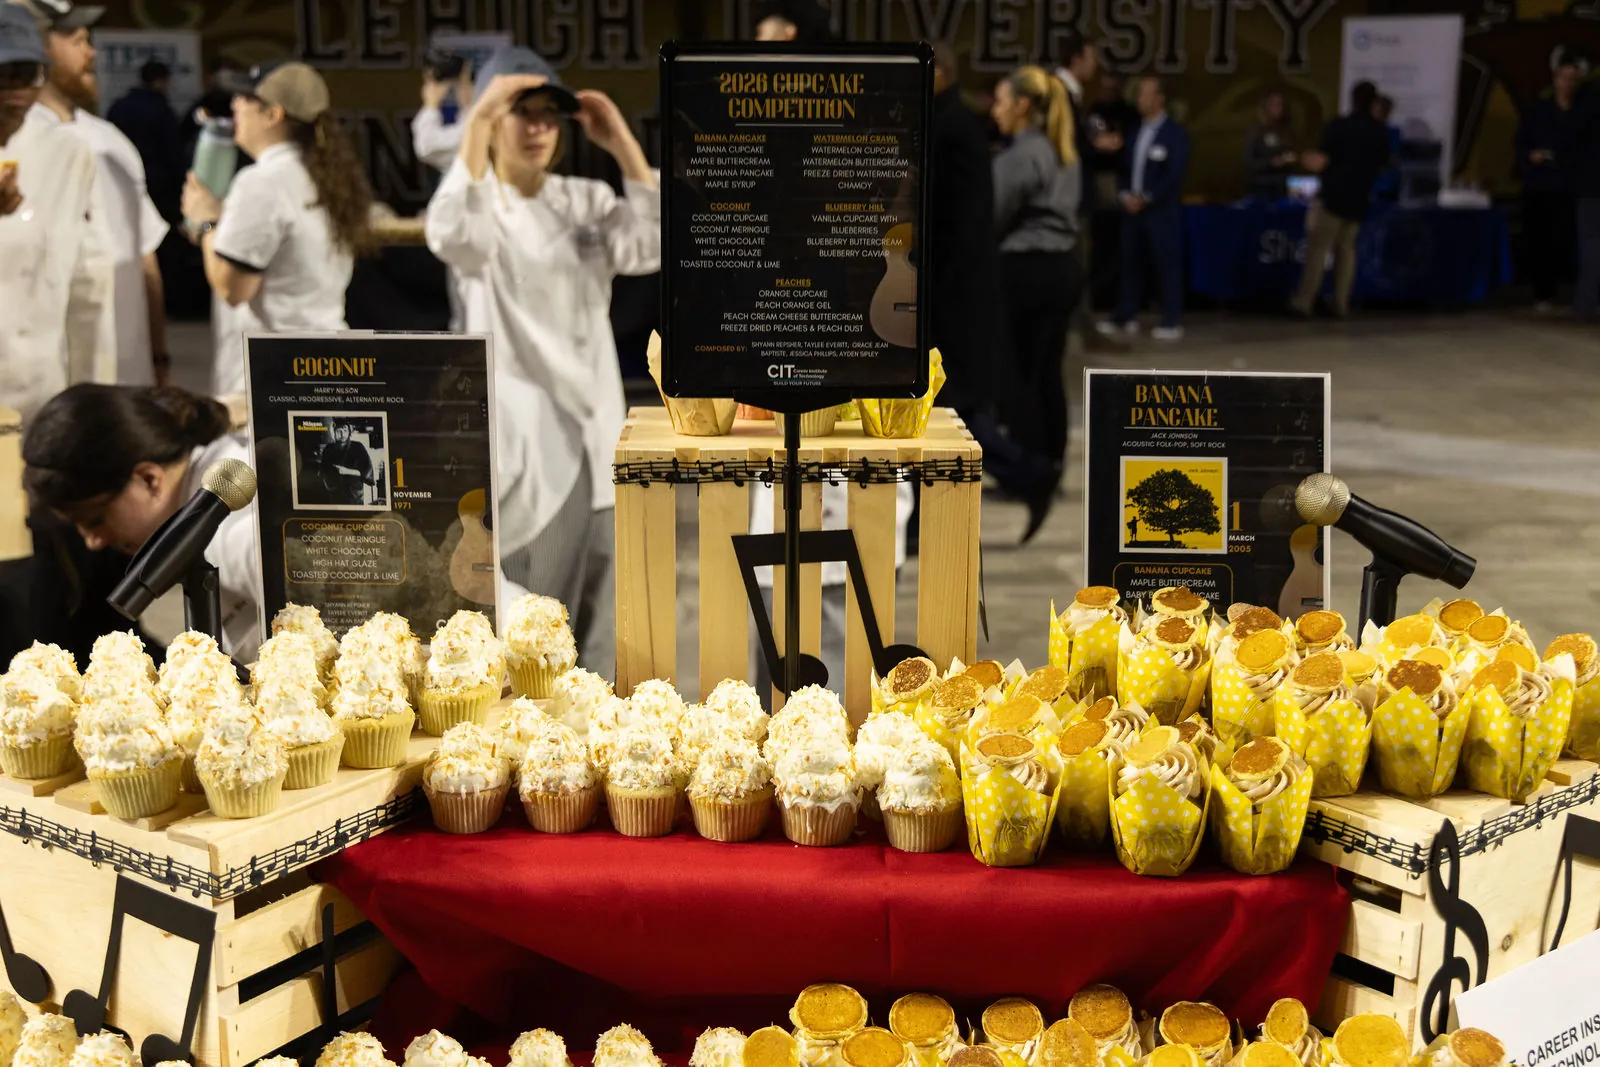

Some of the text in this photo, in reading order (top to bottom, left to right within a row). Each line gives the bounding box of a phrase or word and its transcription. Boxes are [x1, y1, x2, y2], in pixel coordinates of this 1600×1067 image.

[720, 72, 864, 94] 2026 CUPCAKE
[729, 98, 856, 119] COMPETITION
[838, 181, 872, 190] CHAMOY
[756, 301, 831, 309] PEACH ORANGE GEL
[721, 324, 863, 332] FREEZE DRIED PEACHES & PEACH DUST
[293, 357, 377, 377] COCONUT
[767, 364, 795, 378] CIT
[1136, 385, 1213, 403] BANANA
[1131, 408, 1218, 426] PANCAKE
[392, 458, 408, 488] 1
[1229, 502, 1244, 530] 1
[301, 535, 386, 544] COCONUT MERINGUE
[306, 548, 380, 556] WHITE CHOCOLATE
[313, 560, 377, 568] HIGH HAT GLAZE
[292, 571, 399, 580] TOASTED COCONUT & LIME
[1126, 591, 1146, 599] BABY
[1527, 1026, 1578, 1067] CAREER
